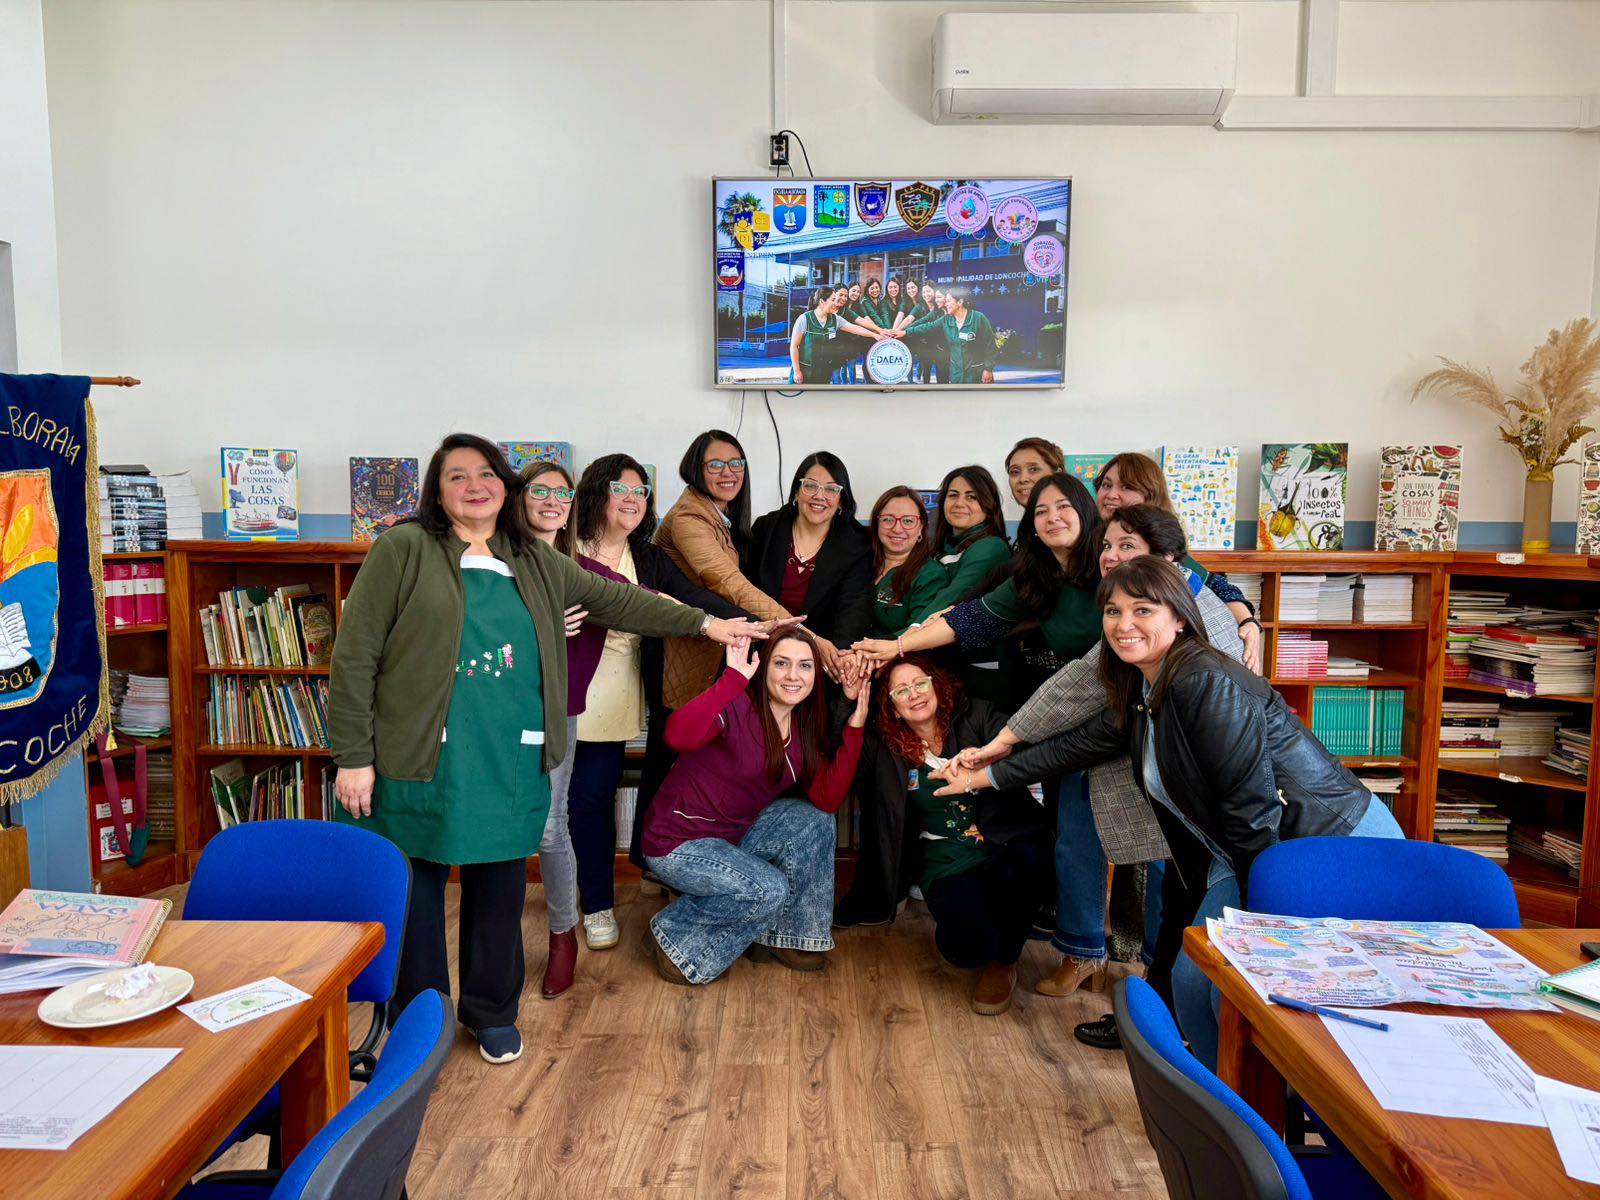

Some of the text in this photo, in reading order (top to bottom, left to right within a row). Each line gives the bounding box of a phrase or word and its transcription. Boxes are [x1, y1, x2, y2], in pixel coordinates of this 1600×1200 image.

[876, 356, 904, 364] DAEM
[242, 476, 289, 484] FUNCIONAN
[251, 485, 272, 494] LAS
[1402, 490, 1434, 498] COSAS
[248, 496, 285, 506] COSAS
[1402, 506, 1432, 518] THINGS
